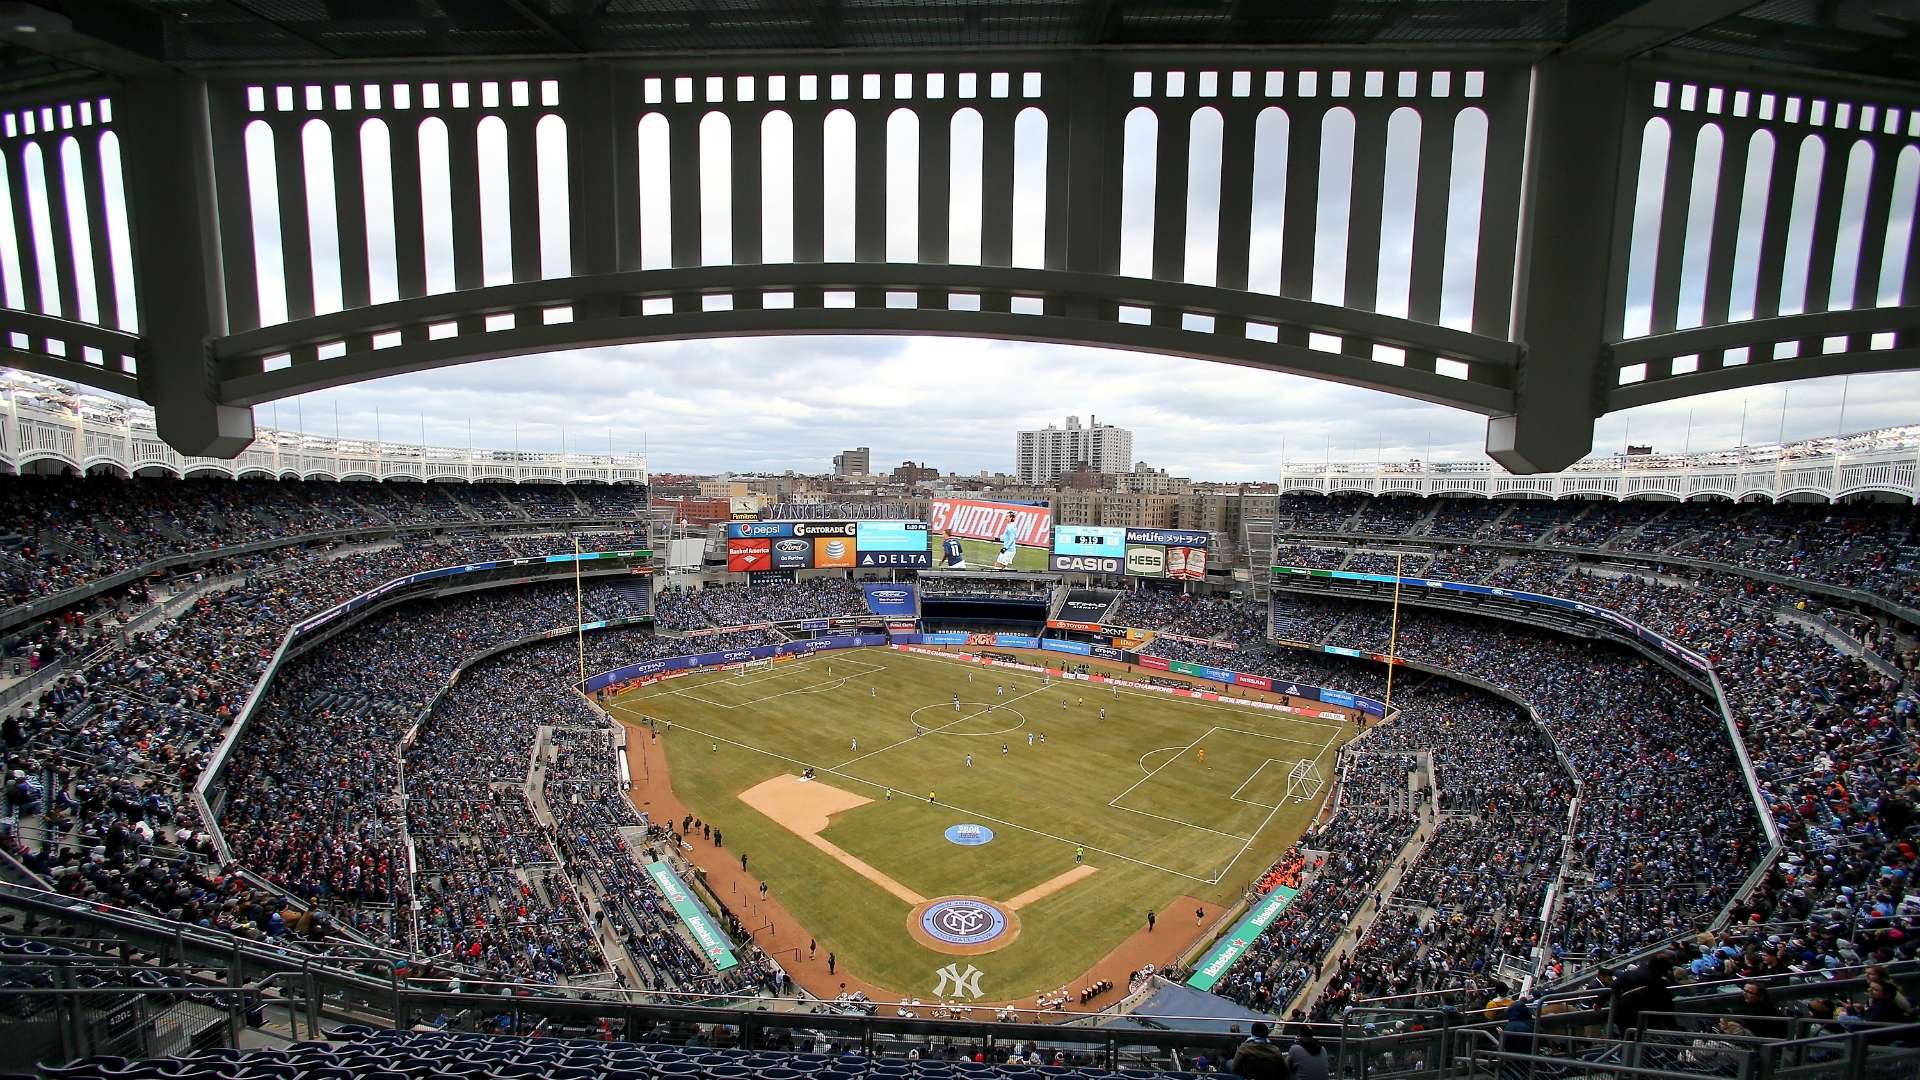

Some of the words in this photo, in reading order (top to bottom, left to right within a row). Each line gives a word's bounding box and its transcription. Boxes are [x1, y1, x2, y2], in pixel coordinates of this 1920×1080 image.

[768, 503, 832, 520] YANKEE
[839, 502, 911, 520] STADIUM
[753, 525, 780, 536] pepsi
[1079, 536, 1099, 545] 9:19
[1127, 532, 1164, 544] MetLife
[748, 547, 770, 555] America
[878, 554, 927, 565] DELTA
[1128, 555, 1161, 568] HESS
[1056, 559, 1118, 573] CASIO
[1067, 601, 1108, 609] ETIHAD
[1101, 627, 1128, 637] DKNY
[806, 640, 832, 650] ETIHAD
[724, 650, 752, 661] ETIHAD
[638, 661, 666, 673] ETIHAD
[1115, 679, 1135, 689] BUILD
[1134, 682, 1174, 695] CHAMPIONS
[1238, 676, 1266, 687] NISSAN
[688, 915, 719, 948] Heineken
[1203, 945, 1239, 977] Heineken
[932, 962, 985, 1000] NY
